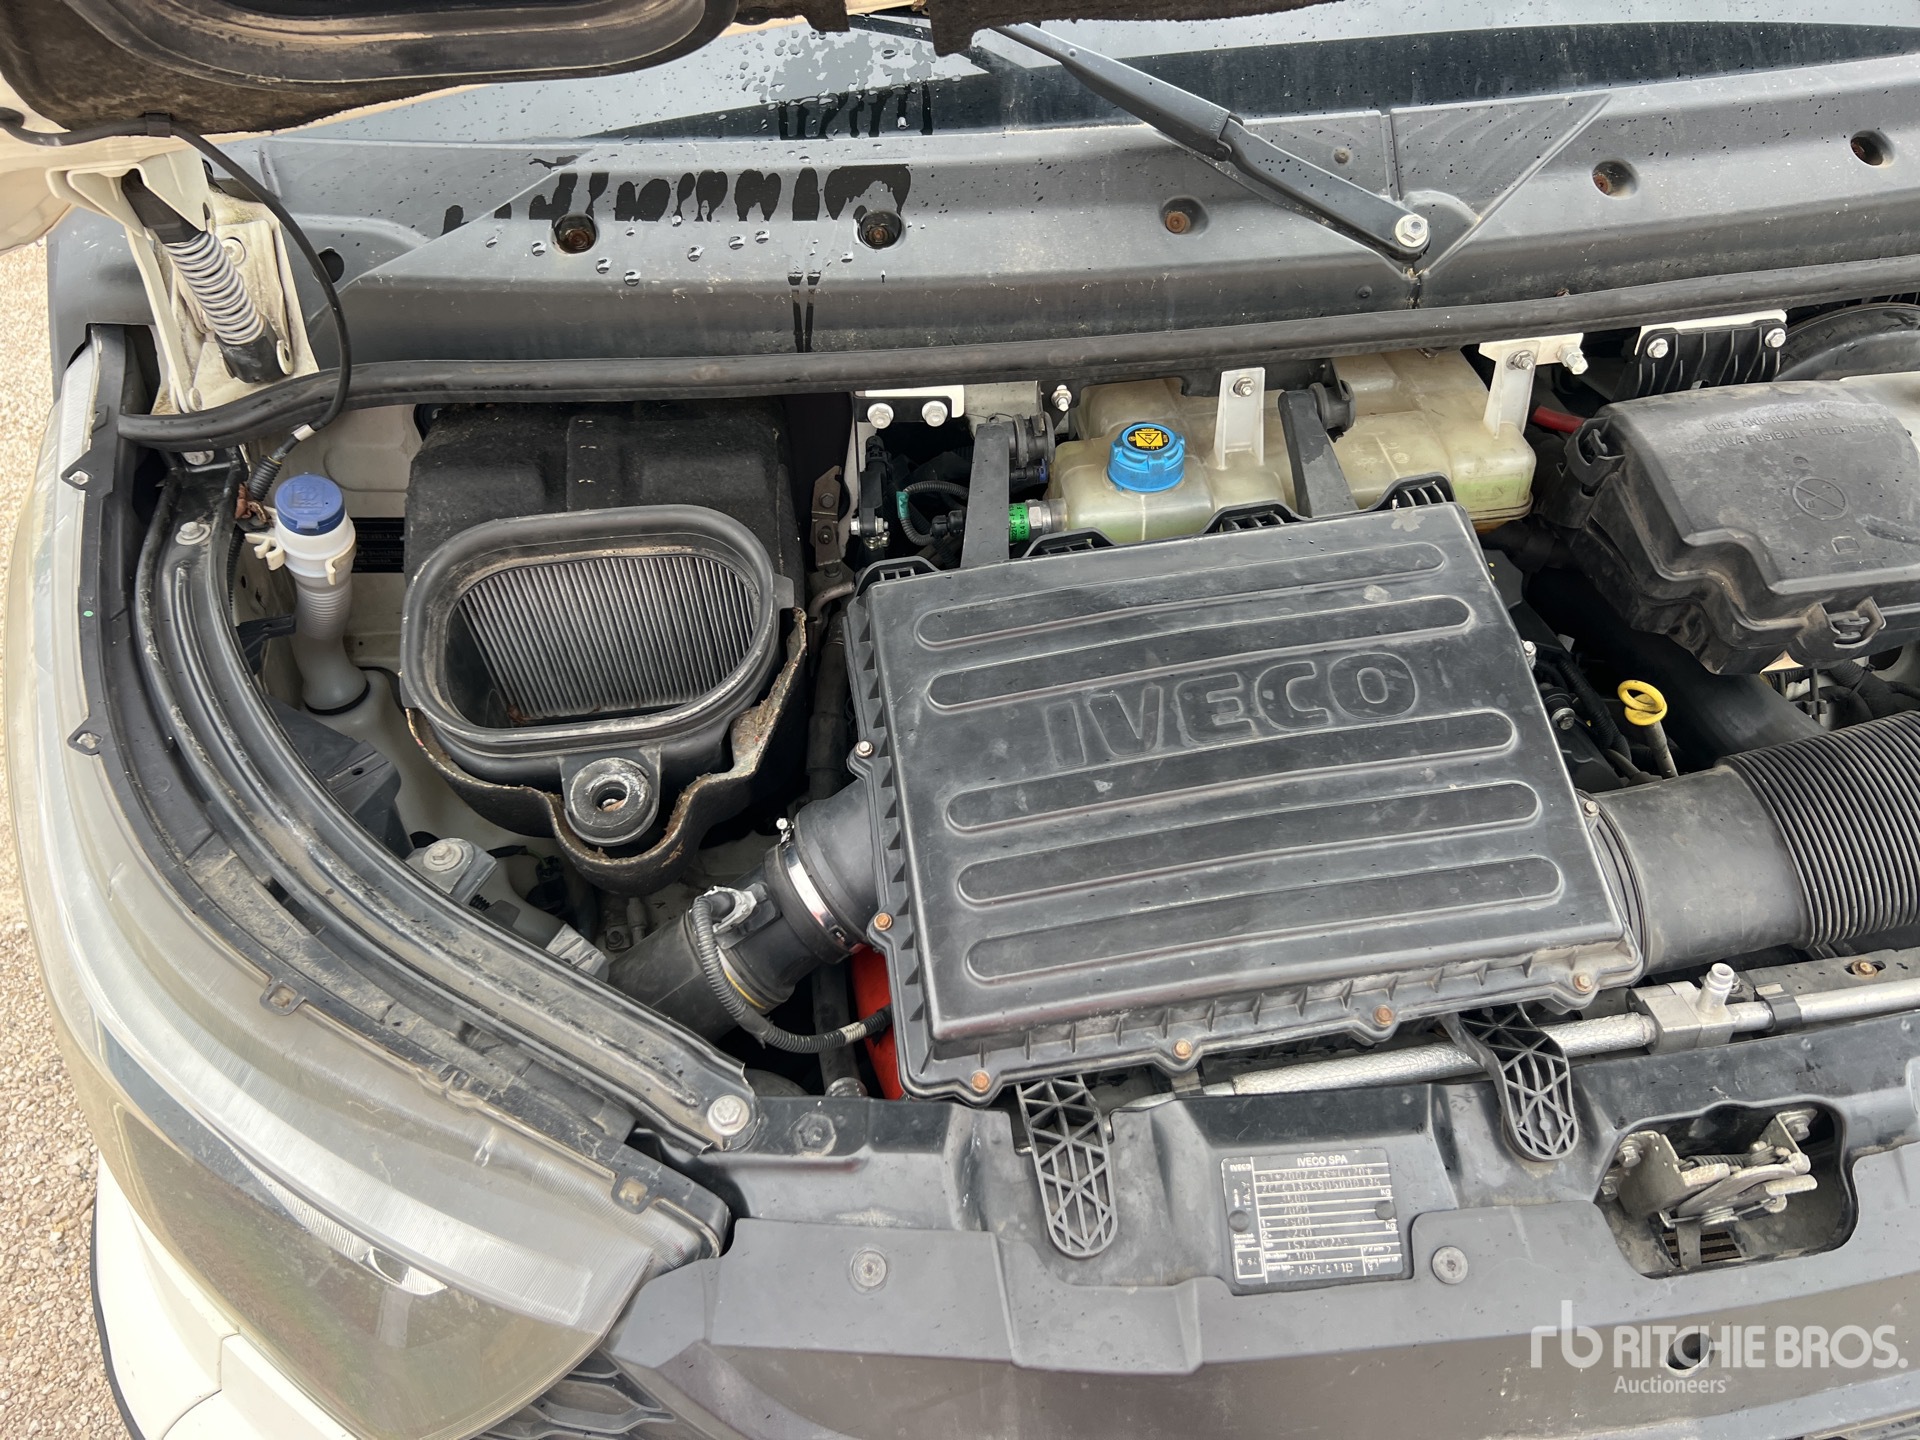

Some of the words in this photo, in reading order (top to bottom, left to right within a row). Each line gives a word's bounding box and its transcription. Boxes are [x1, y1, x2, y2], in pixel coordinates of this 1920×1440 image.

[1704, 420, 1739, 432] FUSE
[1741, 416, 1767, 428] AND
[1043, 652, 1419, 769] IVECO
[1297, 1156, 1327, 1167] IVECO
[1328, 1154, 1348, 1165] SPA
[1380, 1188, 1391, 1197] kg
[1385, 1222, 1396, 1231] kg
